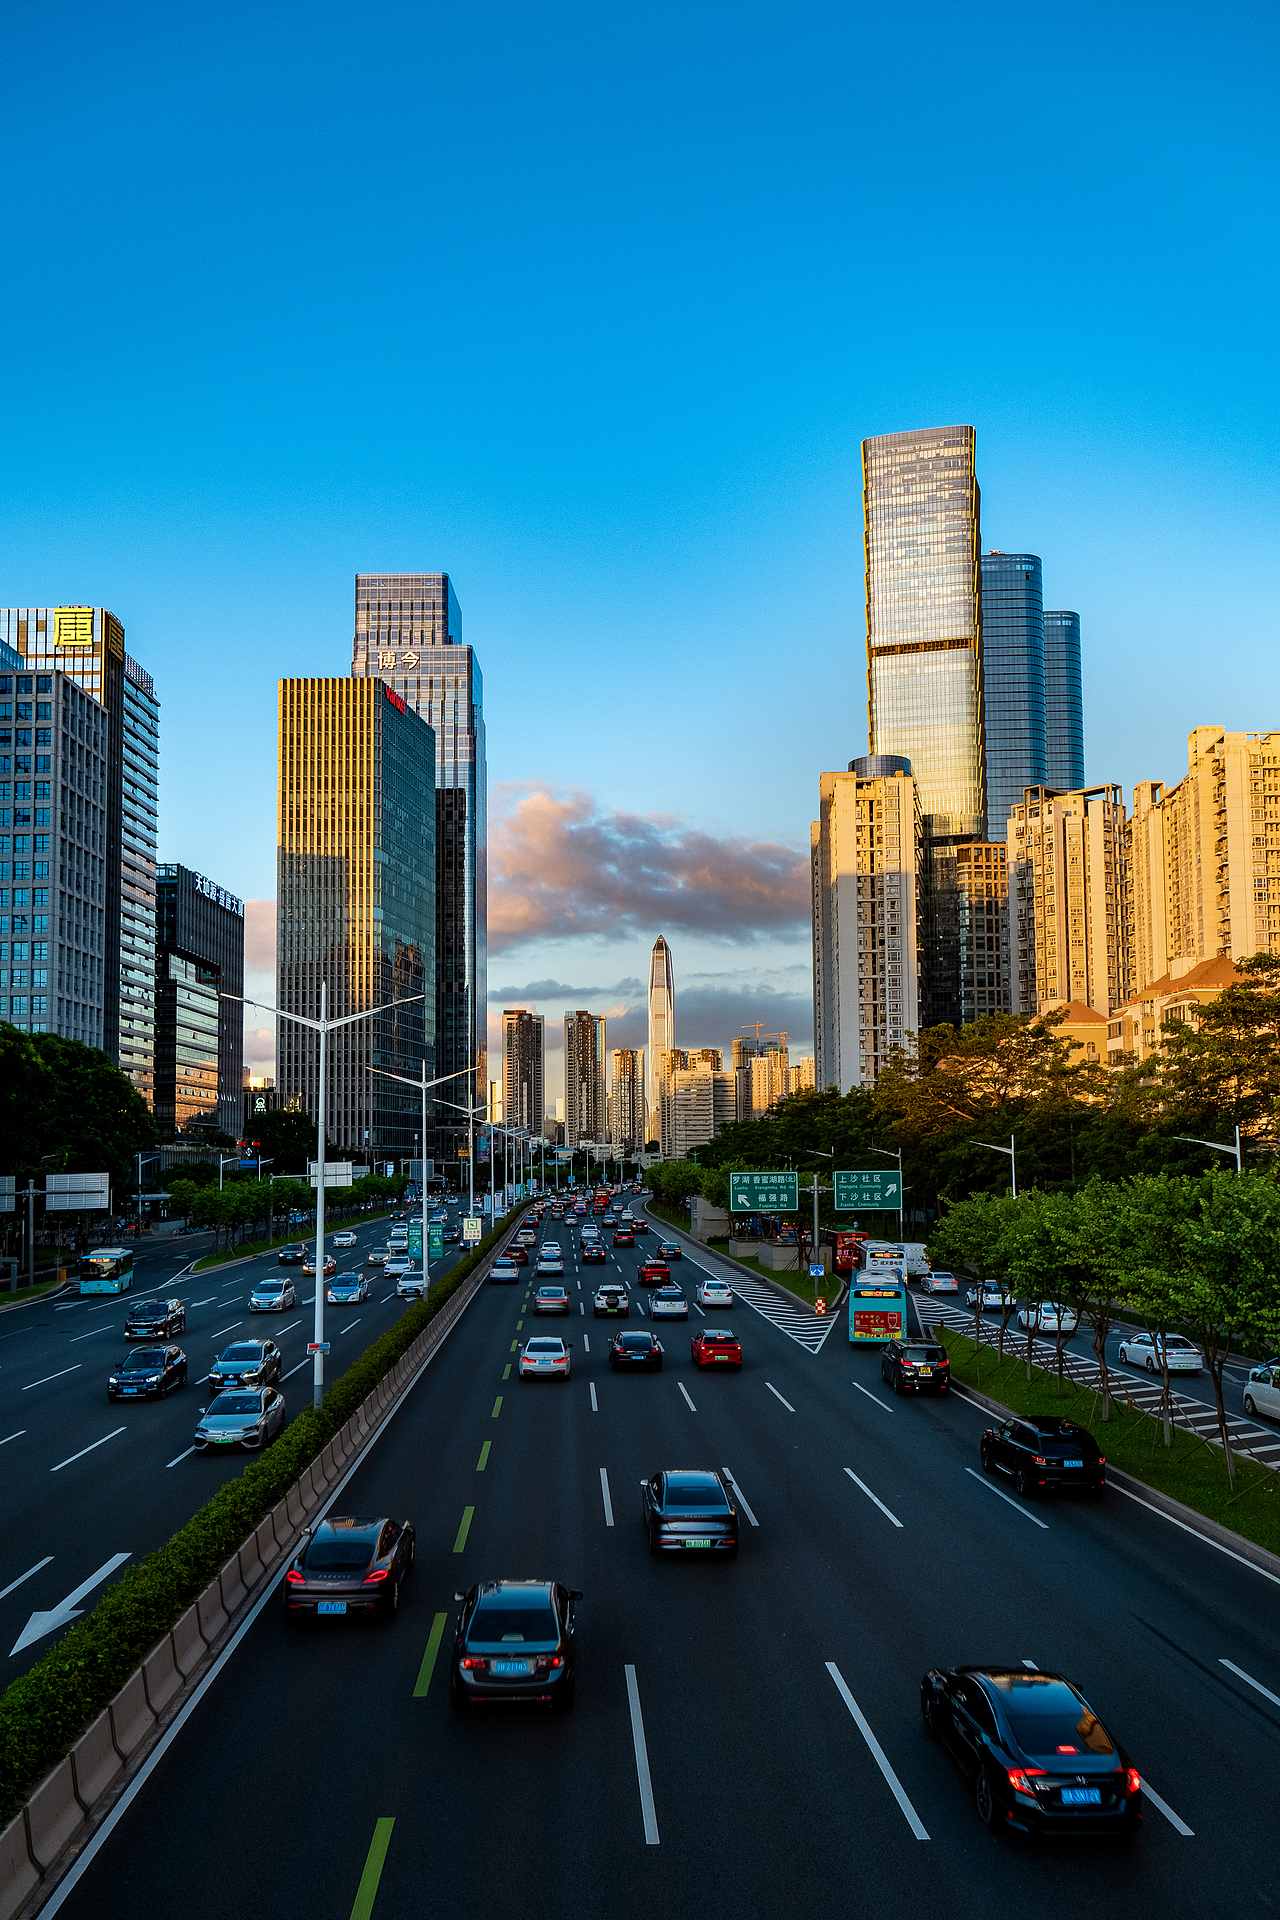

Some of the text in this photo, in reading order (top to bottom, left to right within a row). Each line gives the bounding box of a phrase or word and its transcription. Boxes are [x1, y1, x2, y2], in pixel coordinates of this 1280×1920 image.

[377, 651, 420, 670] 博今
[733, 1175, 750, 1185] 罗湖
[839, 1174, 882, 1184] 上沙社区
[758, 1193, 789, 1202] 福强路
[839, 1192, 882, 1201] 下沙社区
